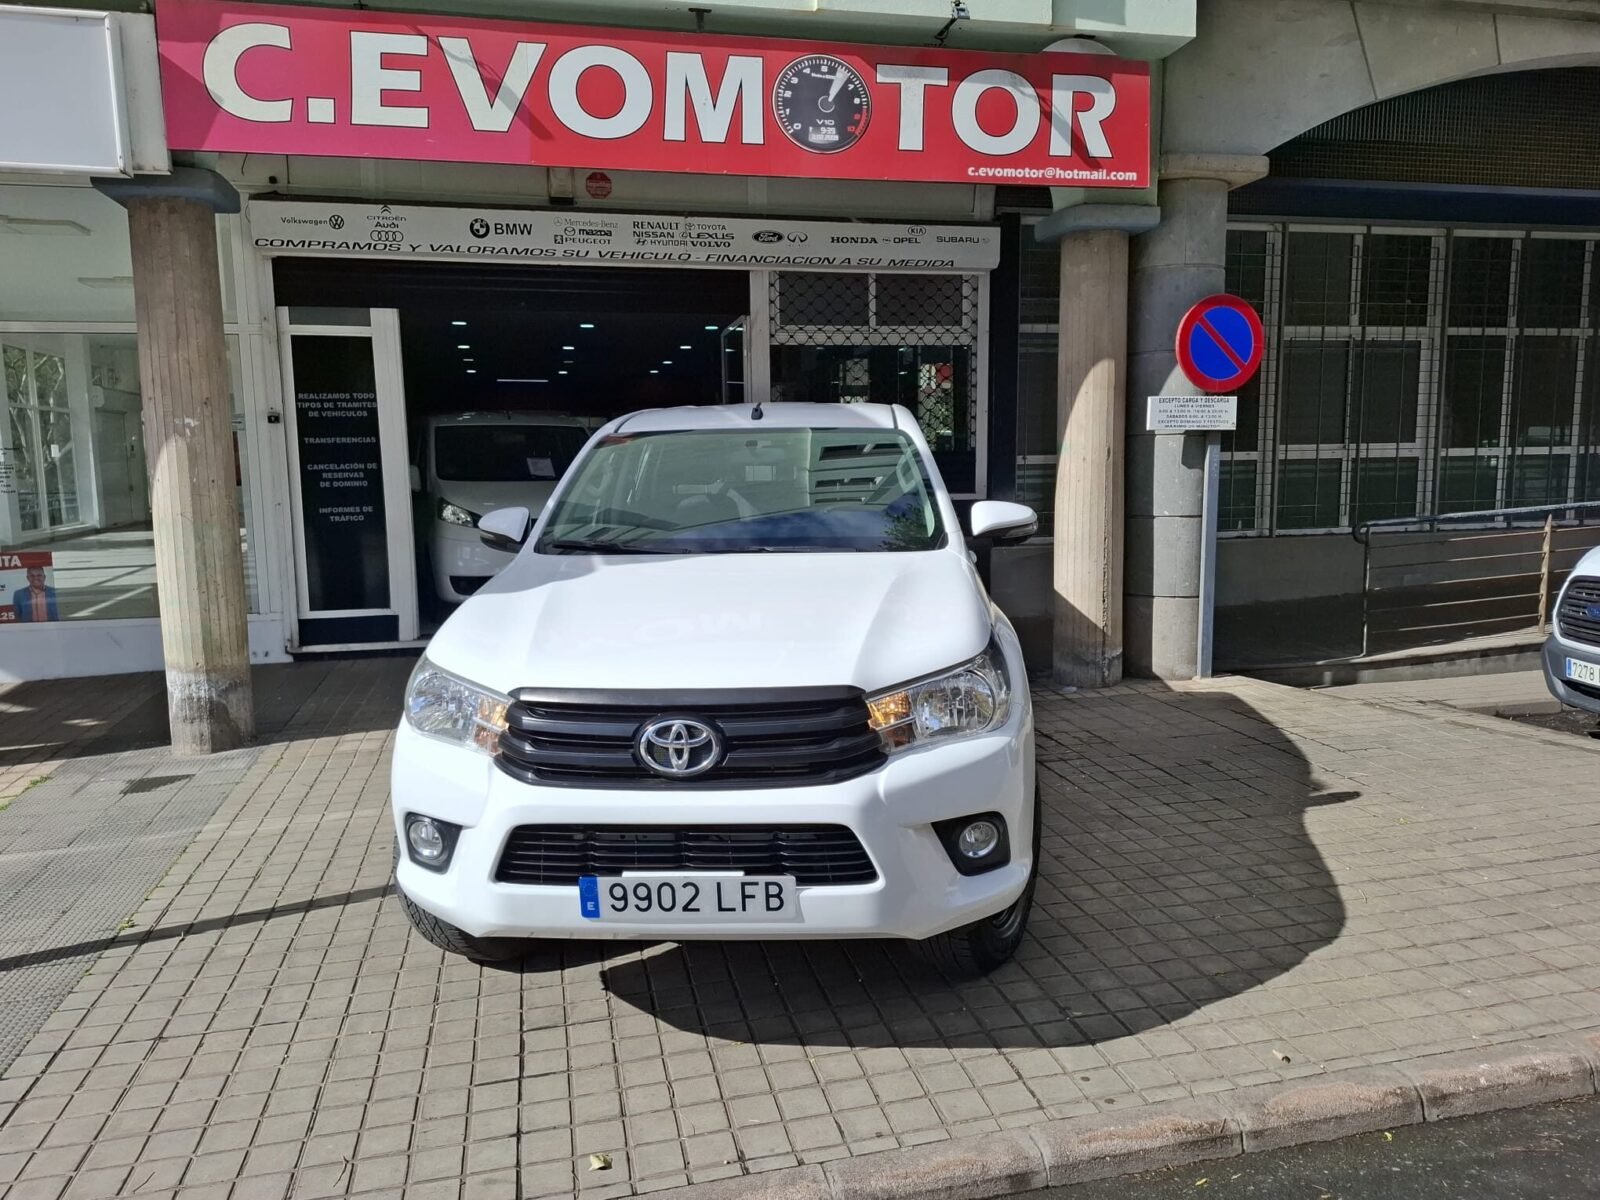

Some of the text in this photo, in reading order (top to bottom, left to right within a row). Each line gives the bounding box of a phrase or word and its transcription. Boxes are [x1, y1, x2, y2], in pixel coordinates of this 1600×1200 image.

[967, 166, 1137, 181] c.evomotor@hotmail.com
[280, 216, 328, 226] Volkswagen
[374, 220, 399, 229] Audi
[564, 218, 618, 228] Mercedes-Benz
[632, 220, 680, 230] RENAULT
[494, 222, 532, 236] BMW
[910, 227, 924, 235] KIA
[632, 230, 735, 240] NISSAN LEXUS
[564, 236, 612, 245] PEUGEOT
[650, 239, 731, 248] HYUNDAI VOLVO
[830, 236, 878, 244] HONDA
[936, 236, 980, 244] SUBARU
[254, 238, 401, 252] COMPRAMOS
[409, 244, 424, 252] Y
[429, 244, 557, 257] VALORAMOS
[561, 249, 590, 258] SU
[598, 250, 691, 262] VEHICULO
[705, 253, 837, 266] FINANCIACION
[839, 258, 853, 266] A
[856, 258, 882, 266] SU
[887, 259, 955, 268] MEDIDA
[298, 392, 350, 400] REALIZAMOS
[304, 436, 376, 444] TRANSFERENCIAS
[306, 462, 378, 470] CANCELACIÓN DE
[332, 480, 368, 488] DOMINIO
[320, 506, 360, 514] INFORMES
[0, 612, 16, 620] 25
[1572, 662, 1595, 681] 7278
[587, 882, 785, 912] E 9902 LFB
